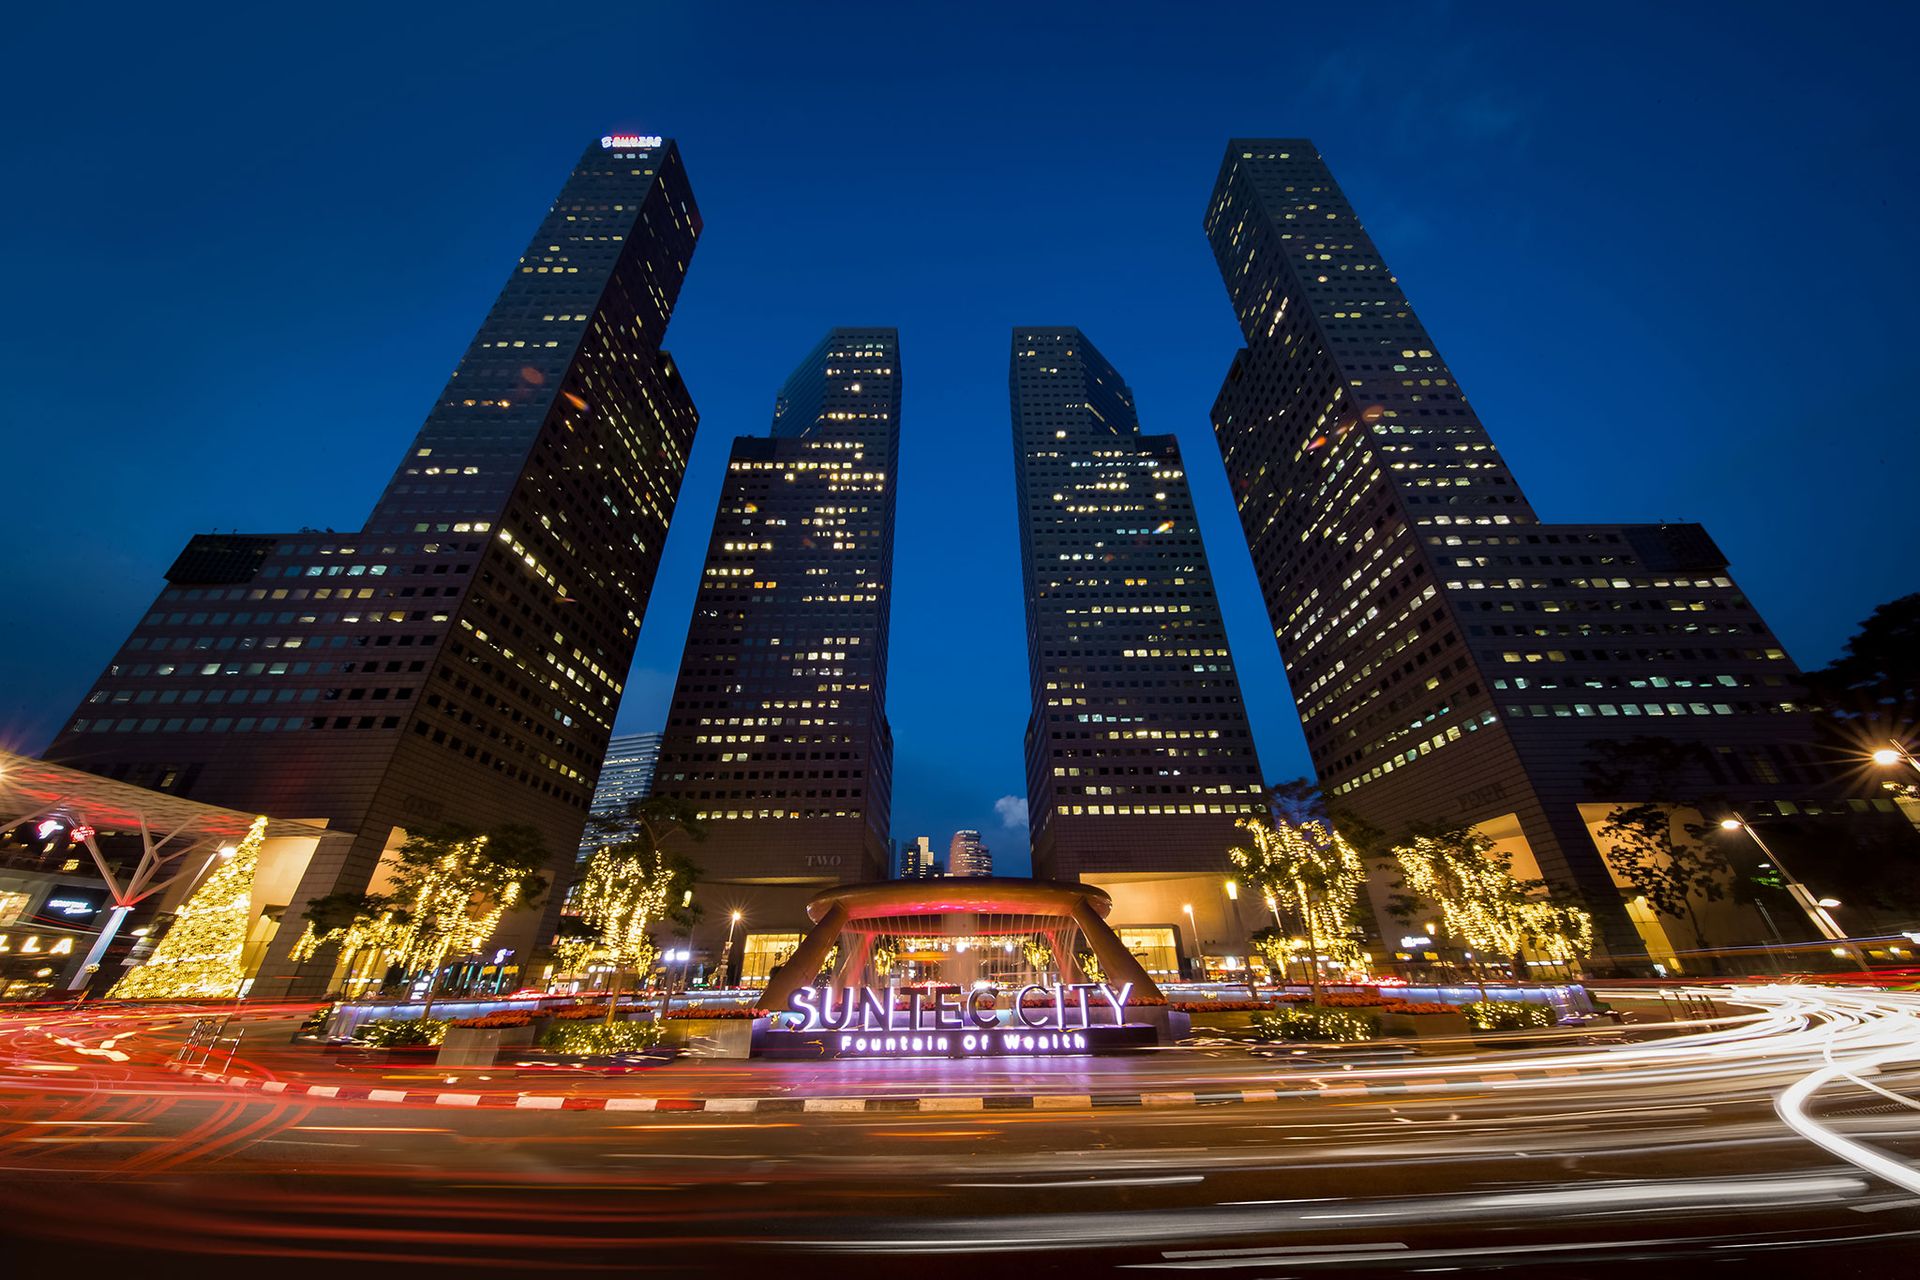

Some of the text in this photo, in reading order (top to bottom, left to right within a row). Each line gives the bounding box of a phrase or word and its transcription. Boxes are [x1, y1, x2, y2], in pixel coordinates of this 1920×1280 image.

[804, 855, 842, 867] TWO
[786, 981, 1134, 1032] SUNTEC CITY
[841, 1033, 1087, 1051] Fountain Of Wealth
